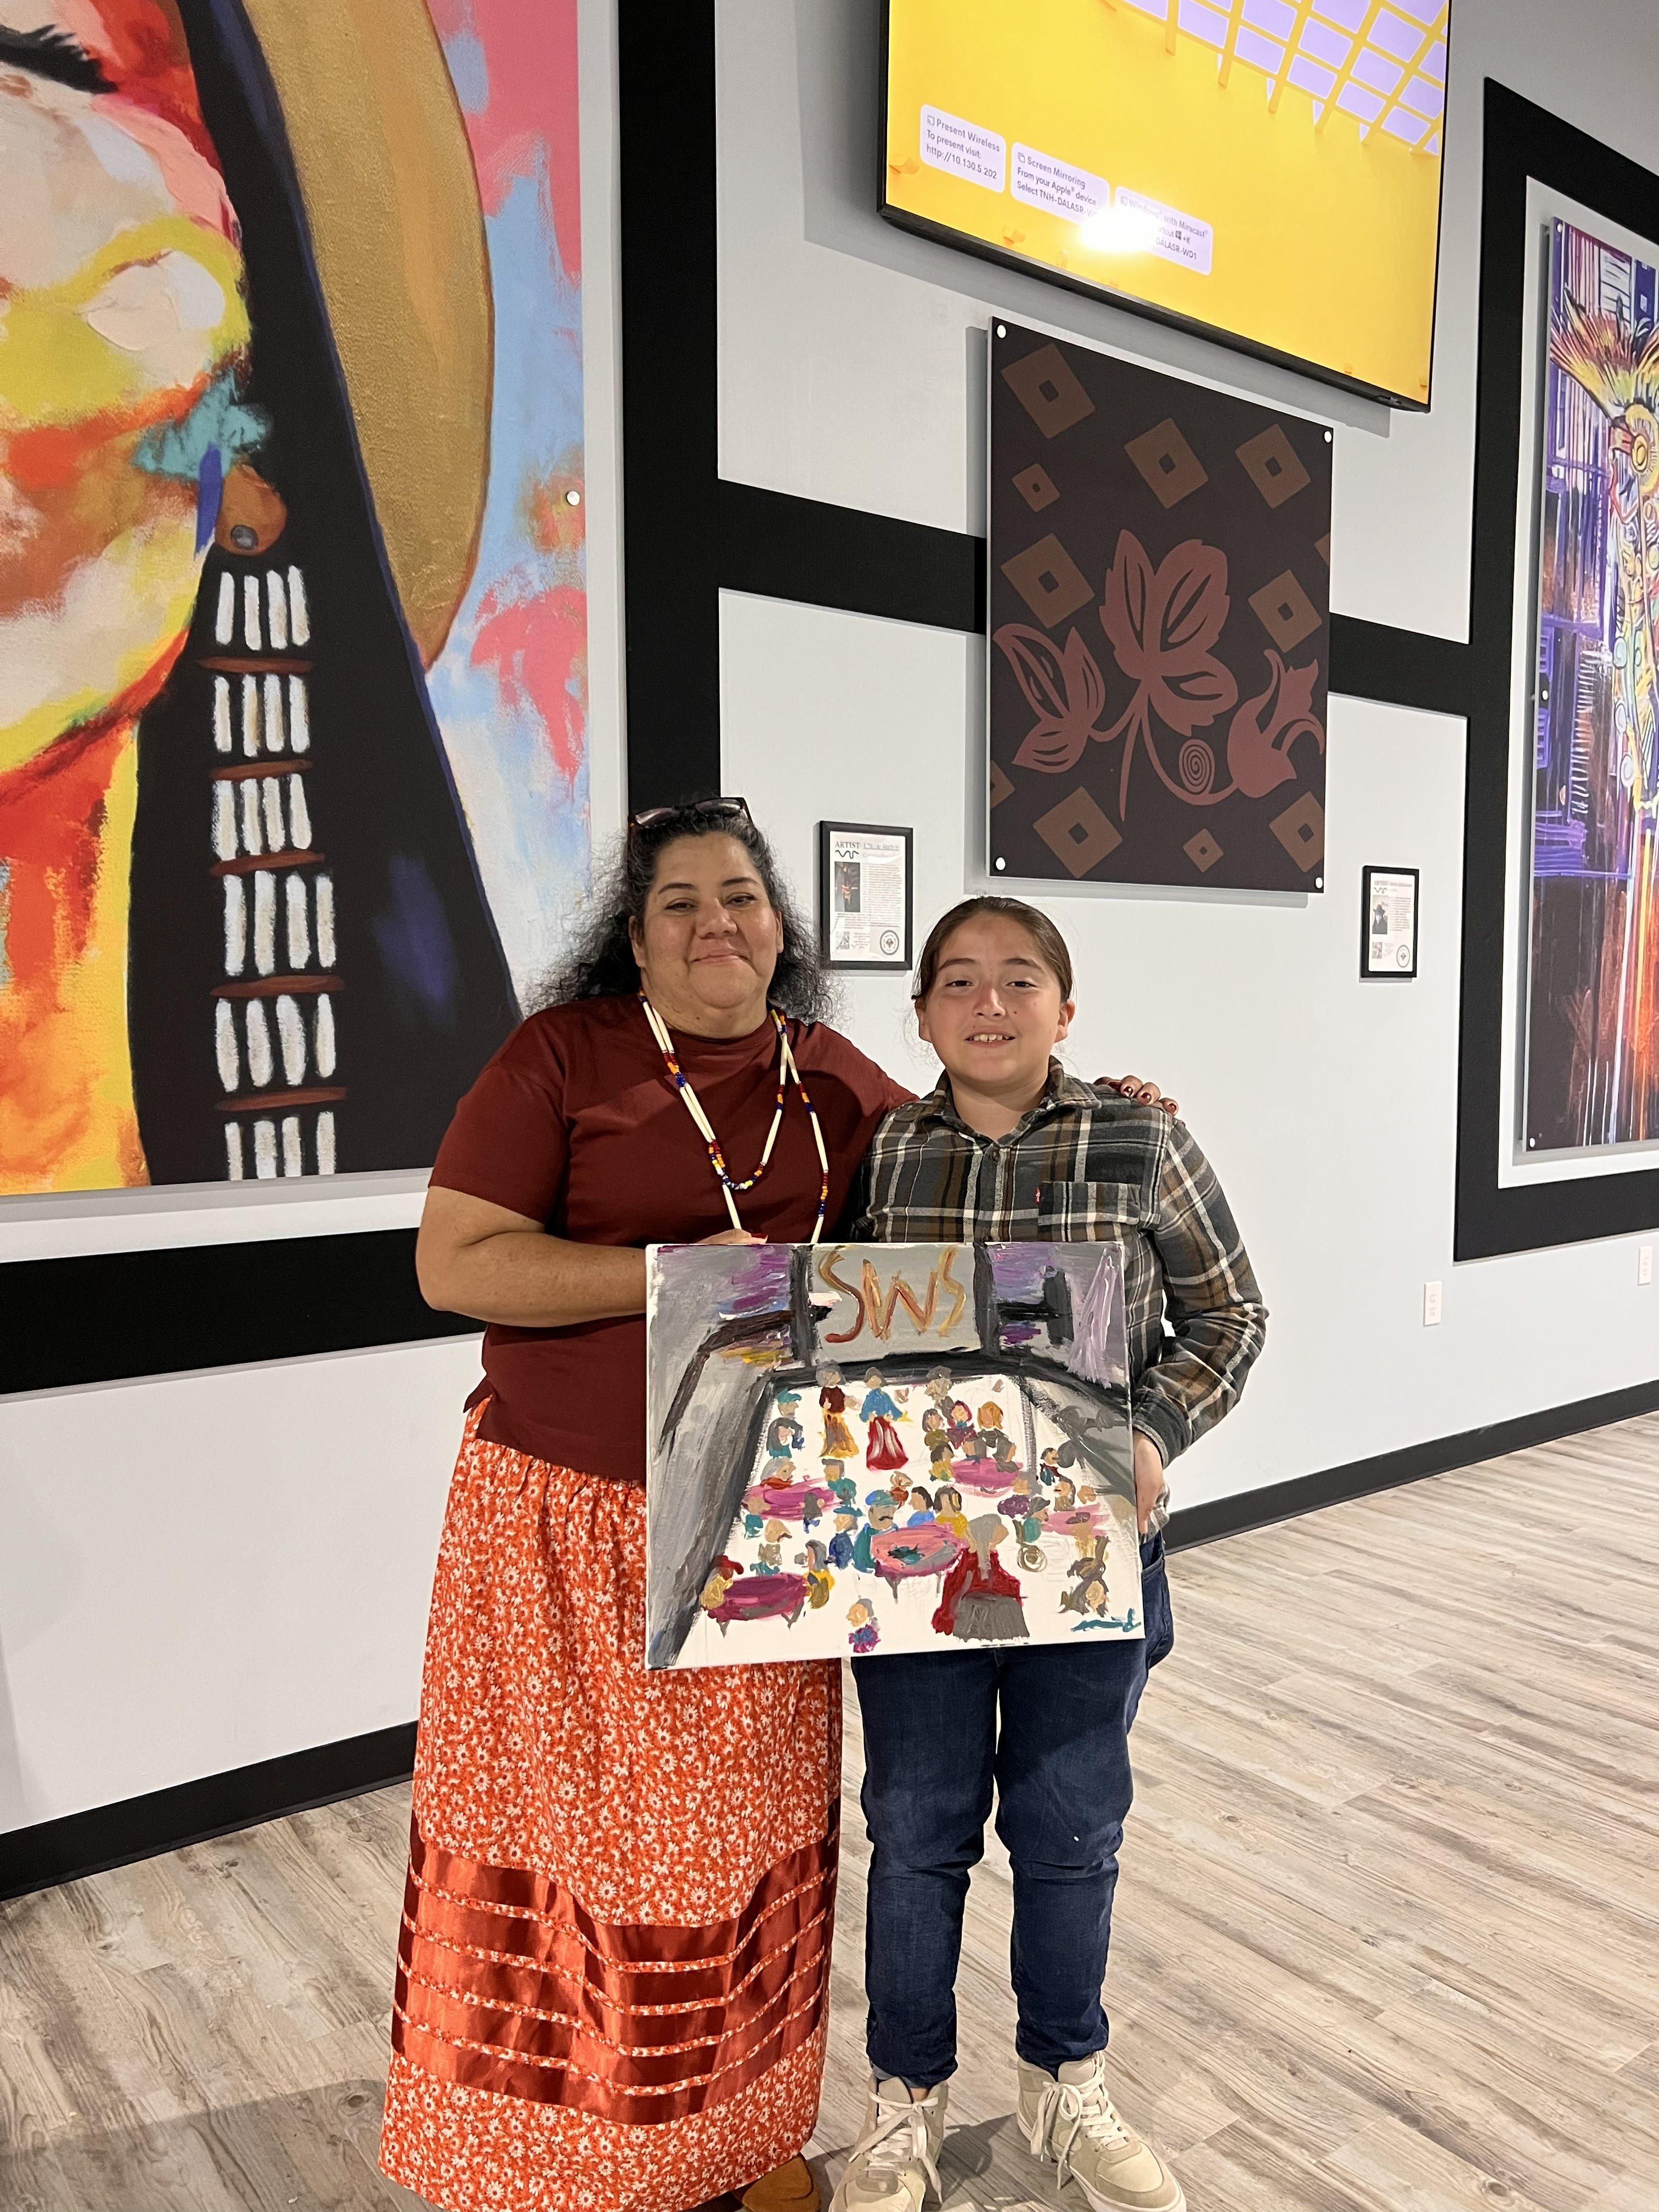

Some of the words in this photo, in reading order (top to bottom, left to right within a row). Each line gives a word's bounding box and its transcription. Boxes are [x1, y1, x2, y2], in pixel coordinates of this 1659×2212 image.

[927, 129, 935, 140] To
[936, 135, 964, 151] present
[966, 146, 982, 159] visit:
[936, 118, 966, 138] Present
[967, 131, 1000, 152] Wireless
[927, 143, 997, 179] http://10.130.5.202
[1027, 156, 1052, 174] Screen
[1053, 167, 1086, 190] Mirroring
[1017, 167, 1035, 180] From
[1036, 176, 1050, 187] your
[1075, 191, 1097, 206] device
[1017, 180, 1038, 195] Select
[1164, 215, 1177, 227] with
[818, 1244, 966, 1342] SWS
